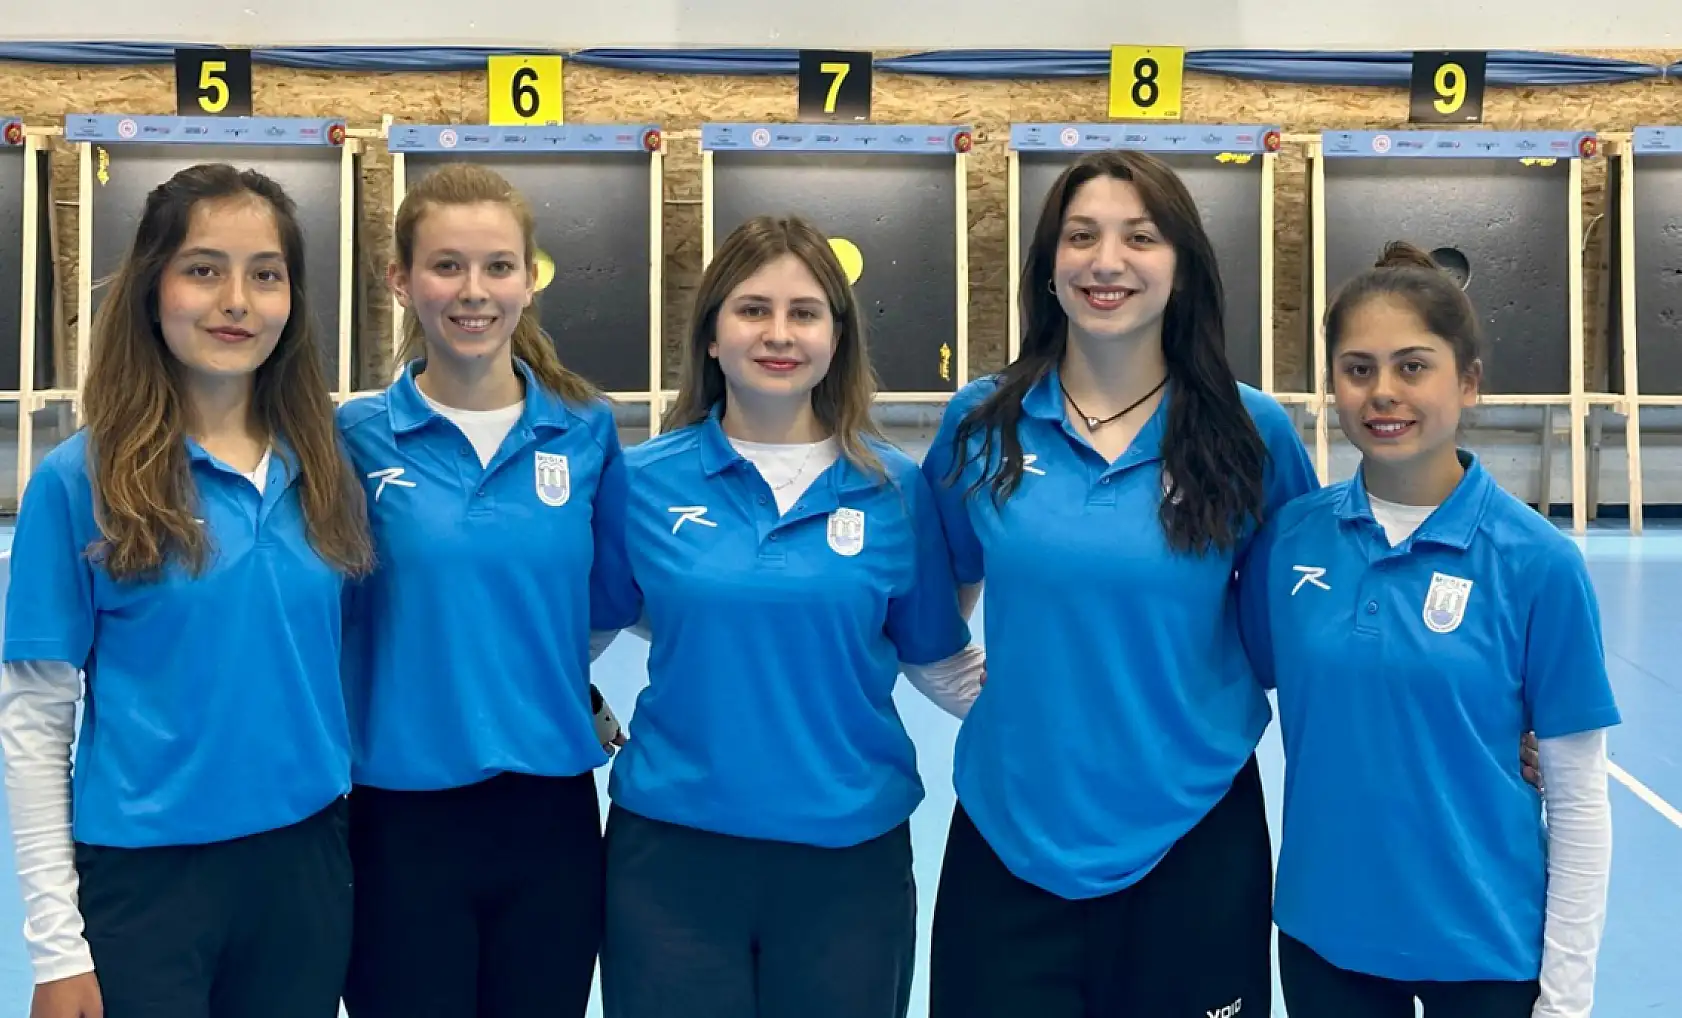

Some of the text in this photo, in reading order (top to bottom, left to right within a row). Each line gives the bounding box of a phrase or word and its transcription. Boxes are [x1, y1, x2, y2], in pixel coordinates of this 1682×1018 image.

[198, 61, 230, 113] 5
[512, 67, 540, 118] 6
[820, 63, 850, 113] 7
[1132, 57, 1159, 108] 8
[1433, 62, 1467, 114] 9
